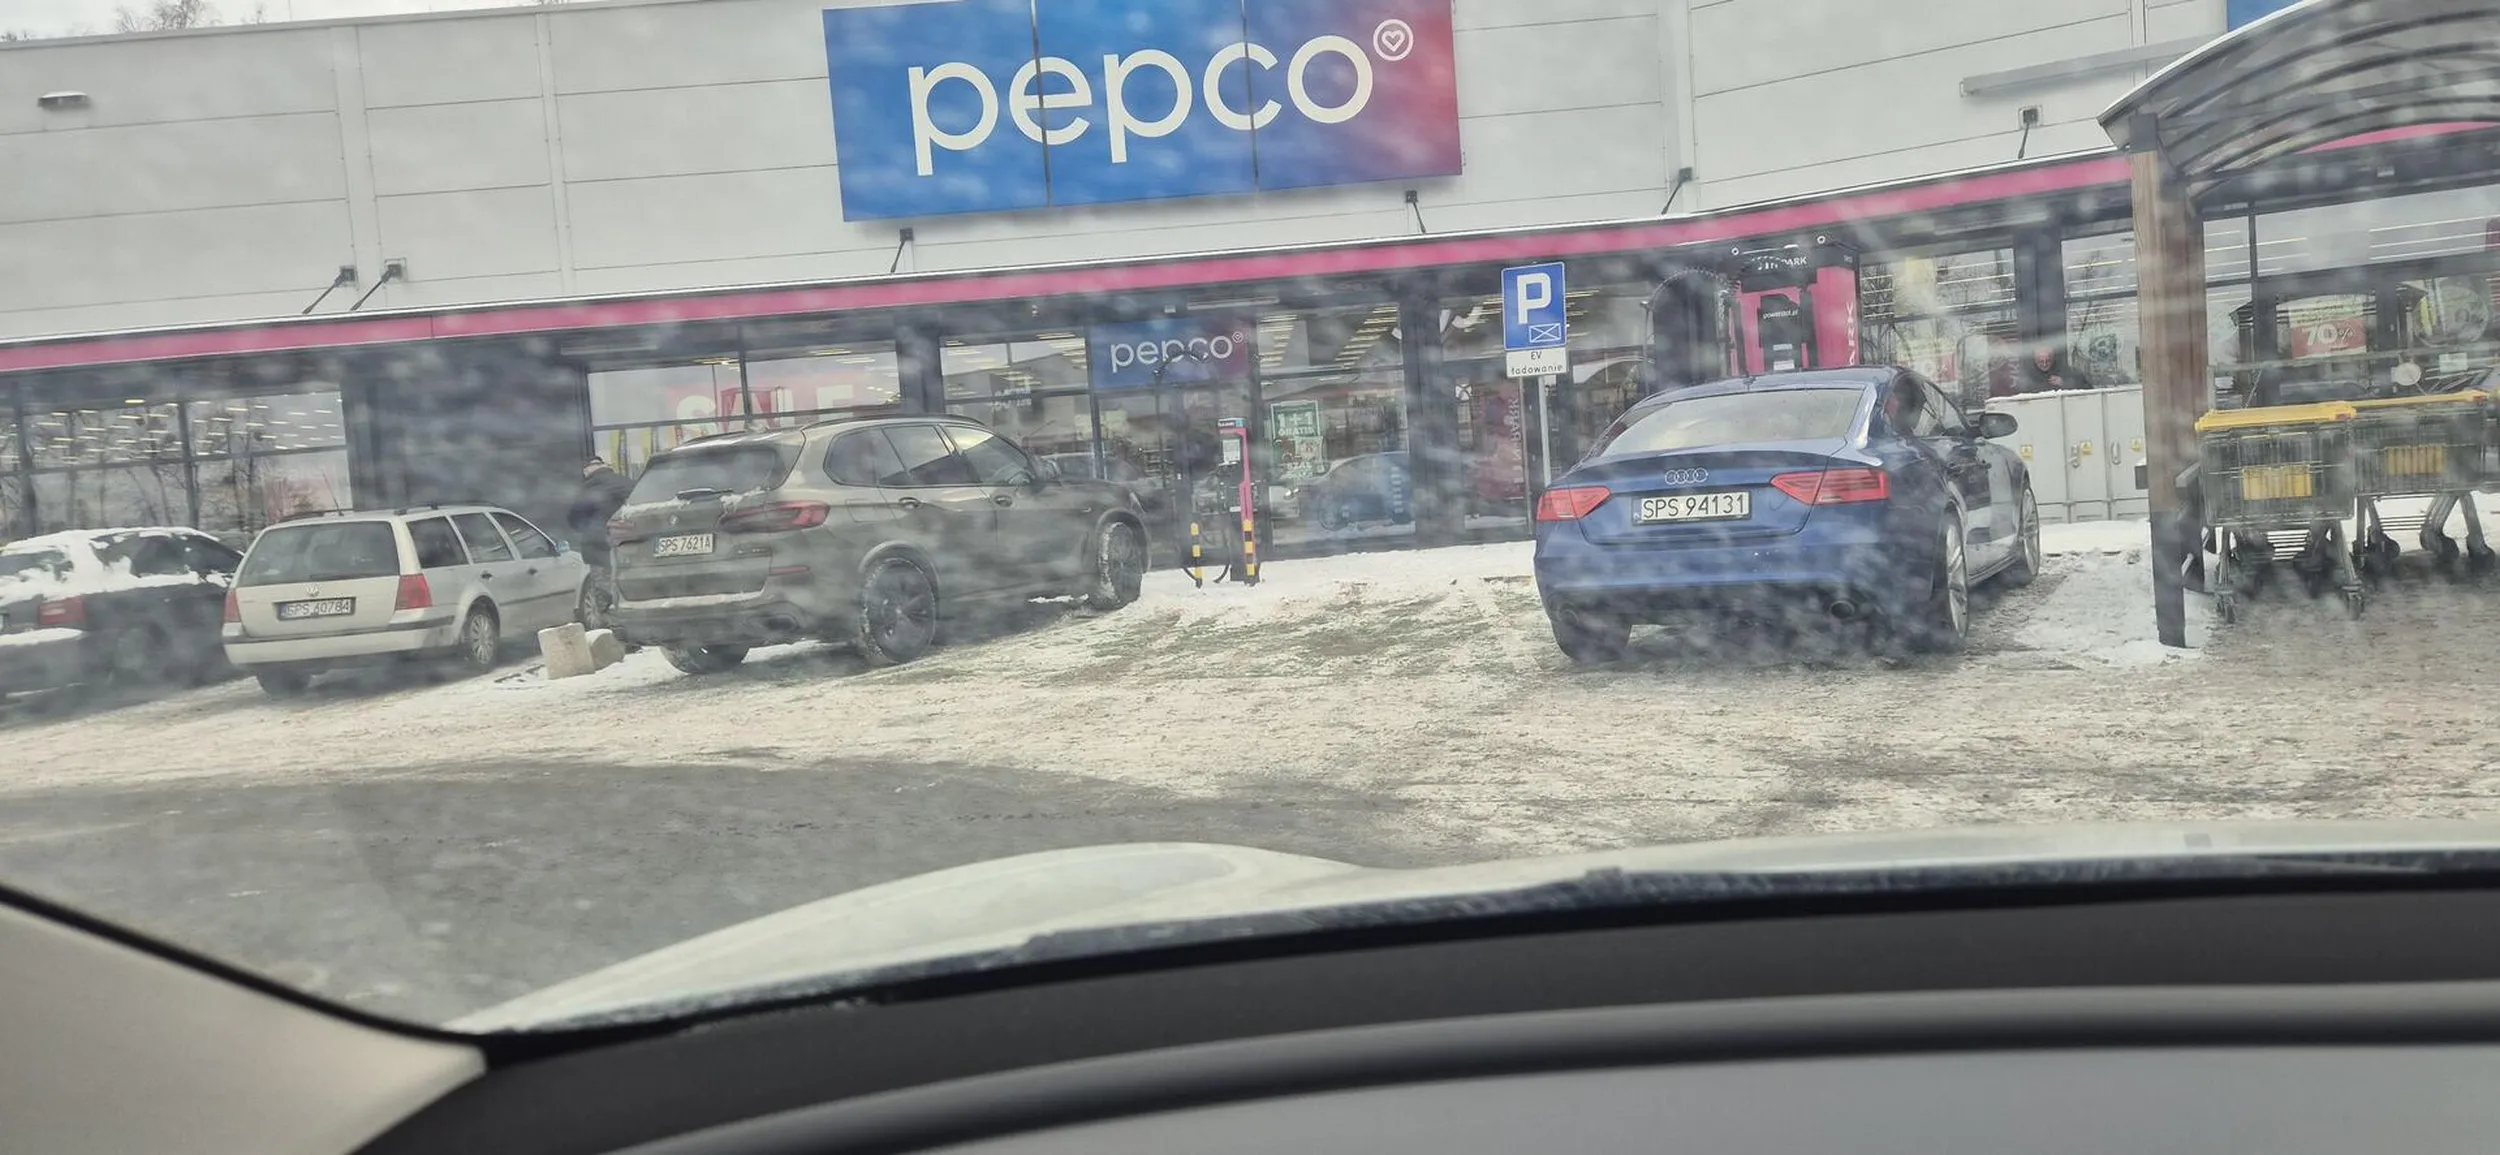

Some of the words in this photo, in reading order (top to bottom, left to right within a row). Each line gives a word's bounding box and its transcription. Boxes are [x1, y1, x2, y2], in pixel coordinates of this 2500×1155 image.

[908, 35, 1373, 176] pepco
[1517, 273, 1551, 324] P
[1110, 335, 1233, 373] pepco
[1530, 351, 1543, 360] EV
[1643, 498, 1679, 518] SPS
[1685, 494, 1744, 516] 94131
